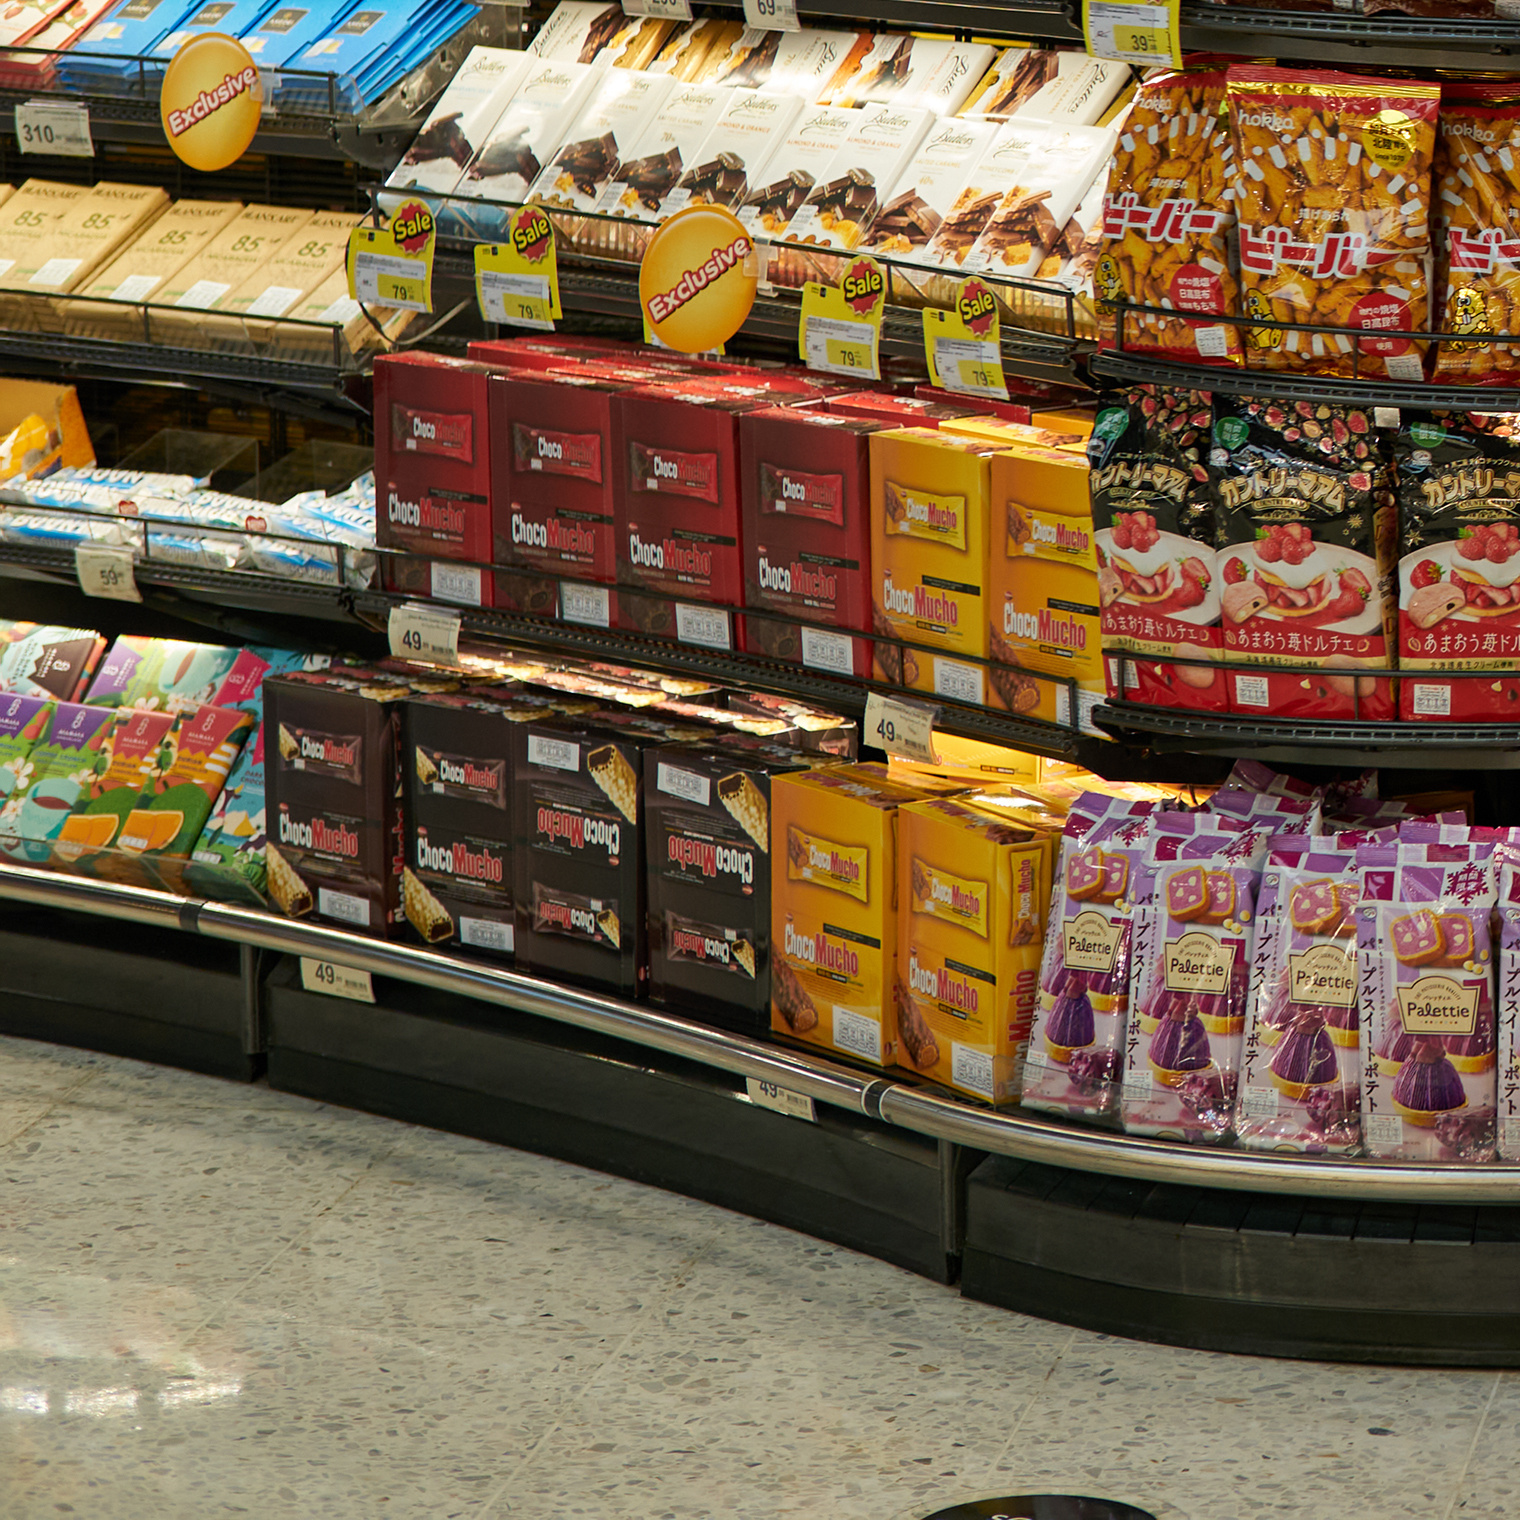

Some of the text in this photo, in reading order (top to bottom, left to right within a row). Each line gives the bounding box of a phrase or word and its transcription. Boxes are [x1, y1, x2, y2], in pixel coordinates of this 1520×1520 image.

[168, 64, 258, 137] Exclusive
[1441, 122, 1496, 143] hokka
[393, 212, 433, 246] Sale
[513, 217, 550, 252] Sale
[1102, 191, 1219, 244] ビーバー
[648, 237, 752, 326] Exclusive
[844, 271, 883, 301] Sale
[958, 290, 995, 325] Sale
[884, 575, 960, 626] ChocoMucho
[1003, 600, 1088, 650] ChocoMucho
[1237, 628, 1356, 654] あまおう苺ドルチェ
[278, 813, 359, 859] ChocoMucho
[417, 837, 503, 883] ChocoMucho
[784, 923, 860, 978] ChocoMucho
[908, 956, 979, 1014] ChocoMucho
[1359, 937, 1379, 1113] パープルスイートポテト
[1406, 1000, 1470, 1019] Palettie
[1504, 937, 1520, 1115] パープルスイートポテト
